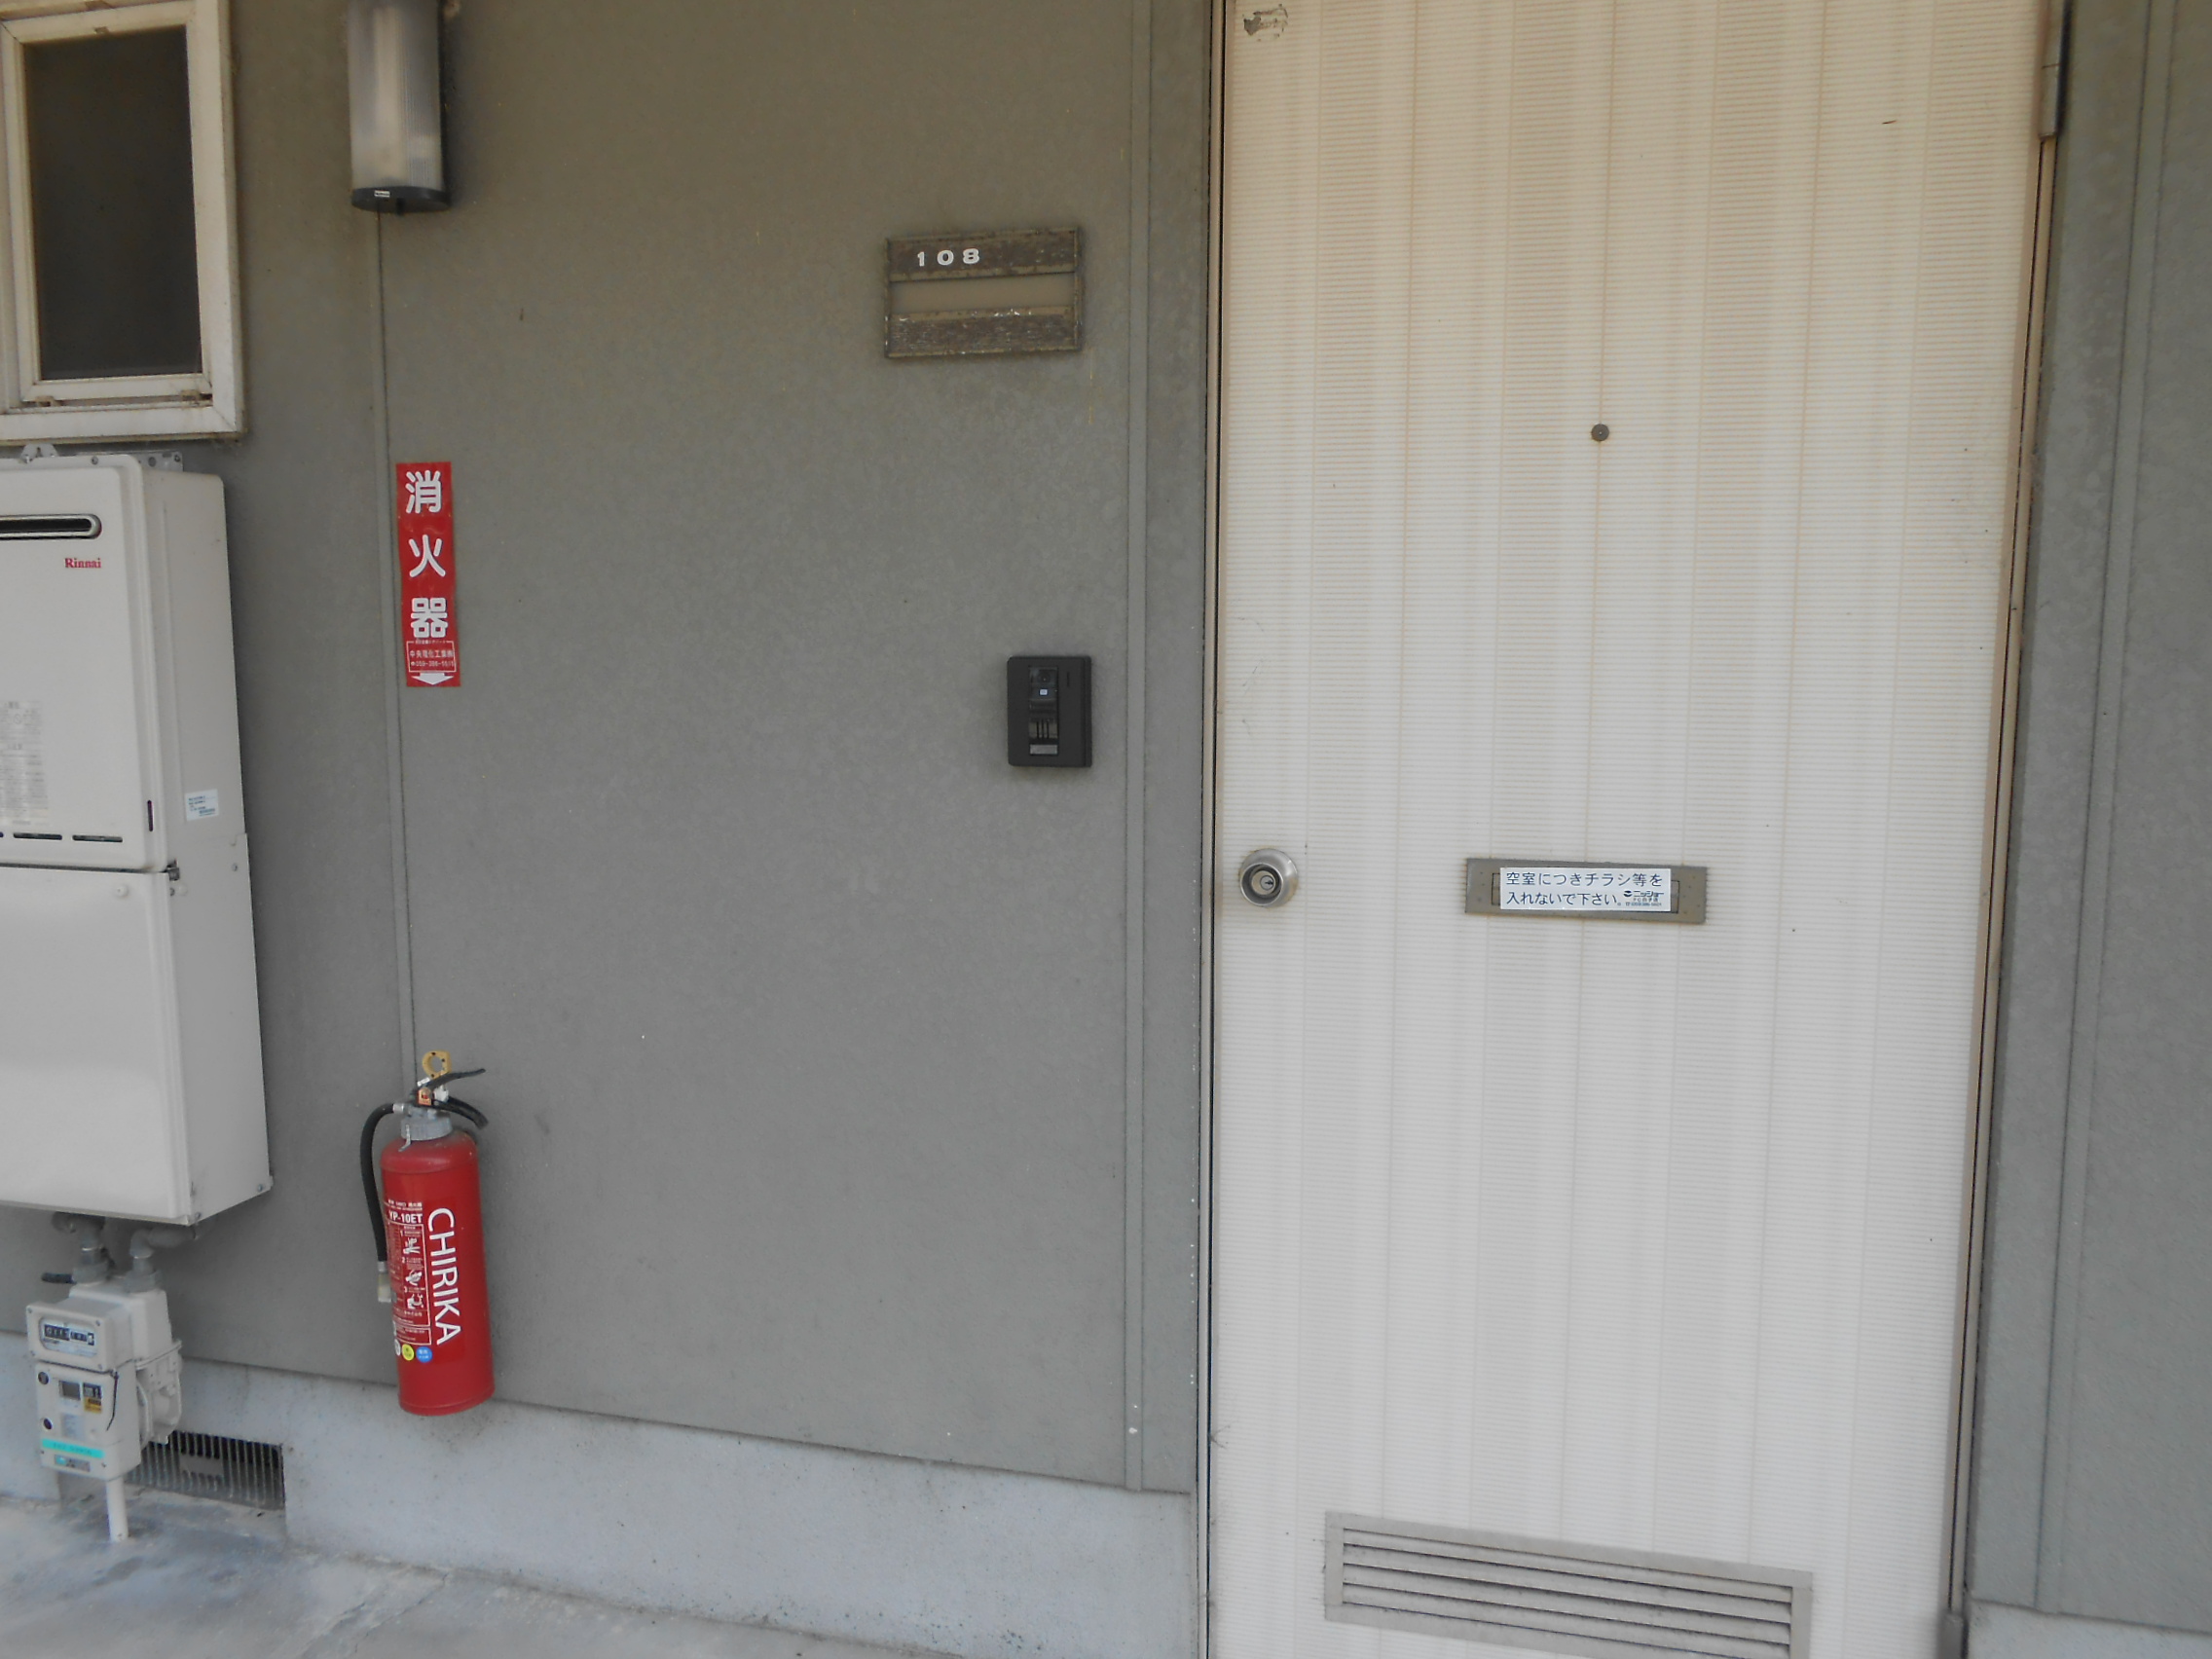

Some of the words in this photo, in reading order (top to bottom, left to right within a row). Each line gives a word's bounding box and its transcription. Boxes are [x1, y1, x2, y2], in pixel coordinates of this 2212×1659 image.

[916, 247, 980, 267] 108
[64, 557, 101, 569] Rinnai
[405, 469, 448, 639] 消火器
[1505, 871, 1664, 888] 空室につきチラシ等を
[1505, 891, 1622, 906] 入れないで下さい。
[427, 1206, 462, 1346] CHIRIKA
